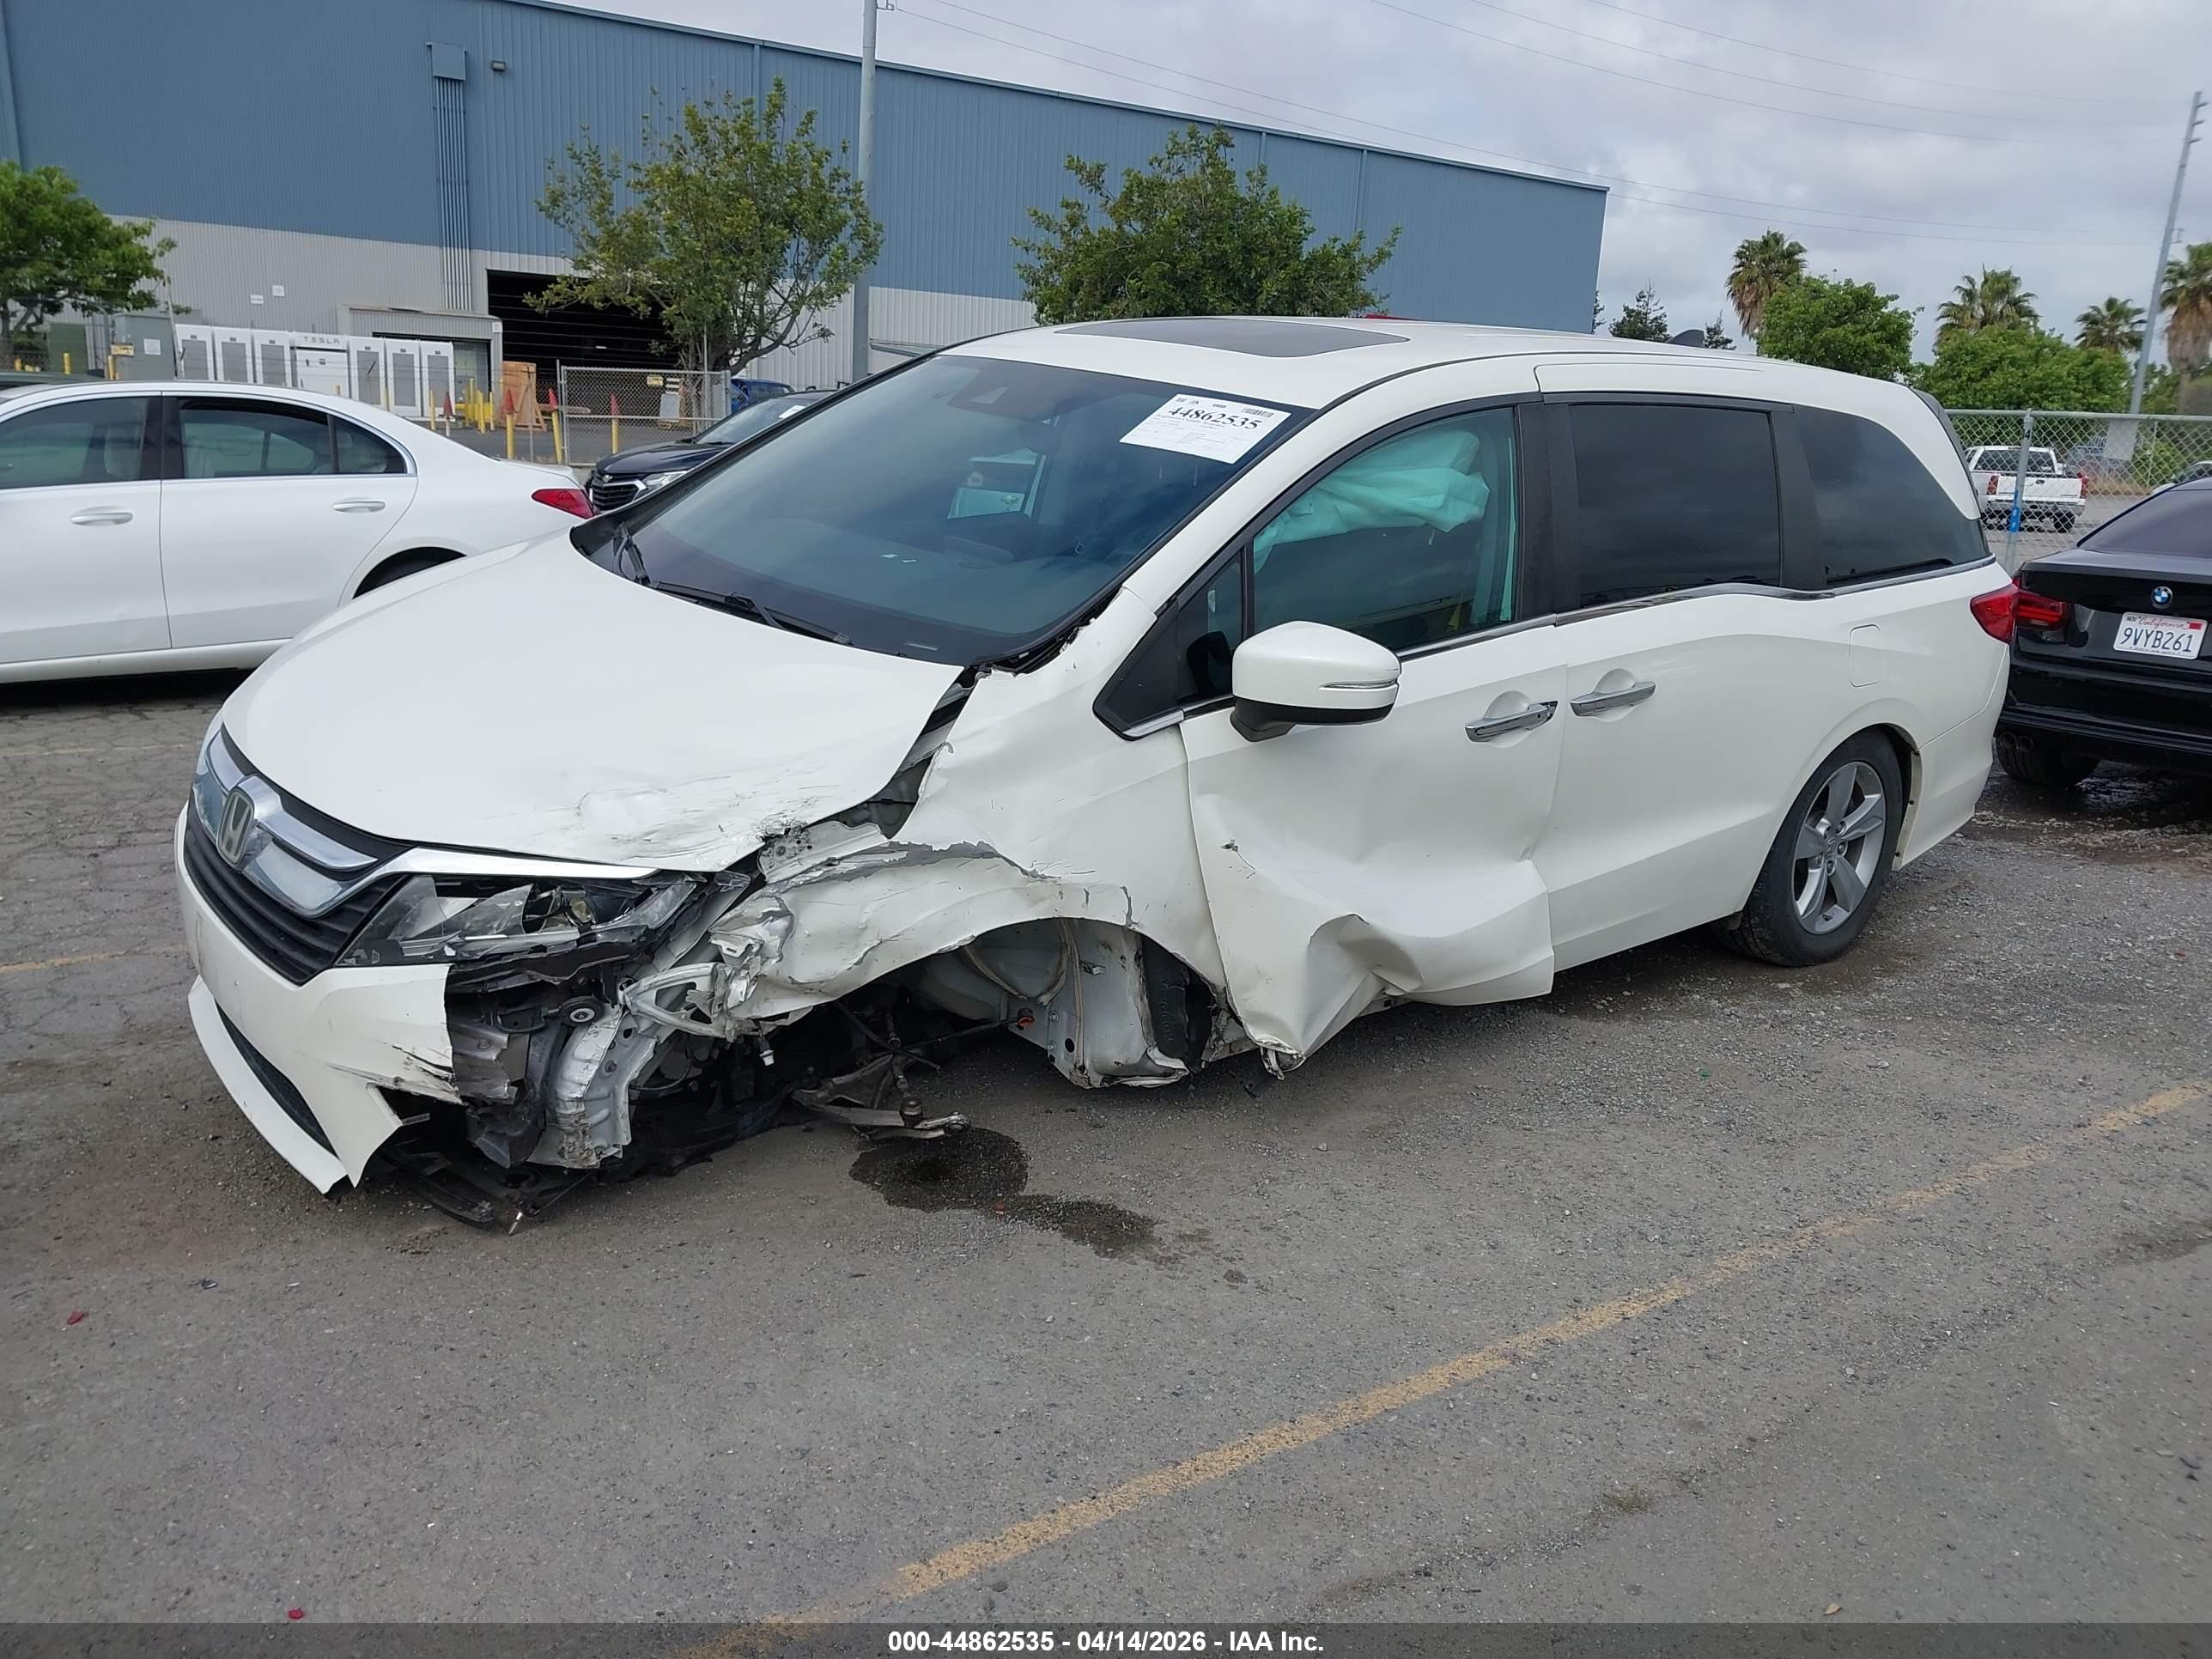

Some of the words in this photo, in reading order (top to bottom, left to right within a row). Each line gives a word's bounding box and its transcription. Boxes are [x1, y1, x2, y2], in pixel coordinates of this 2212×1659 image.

[302, 336, 340, 344] TESLA
[1168, 406, 1262, 430] 44862535
[2138, 617, 2188, 629] California
[2120, 628, 2194, 653] 9VYB261
